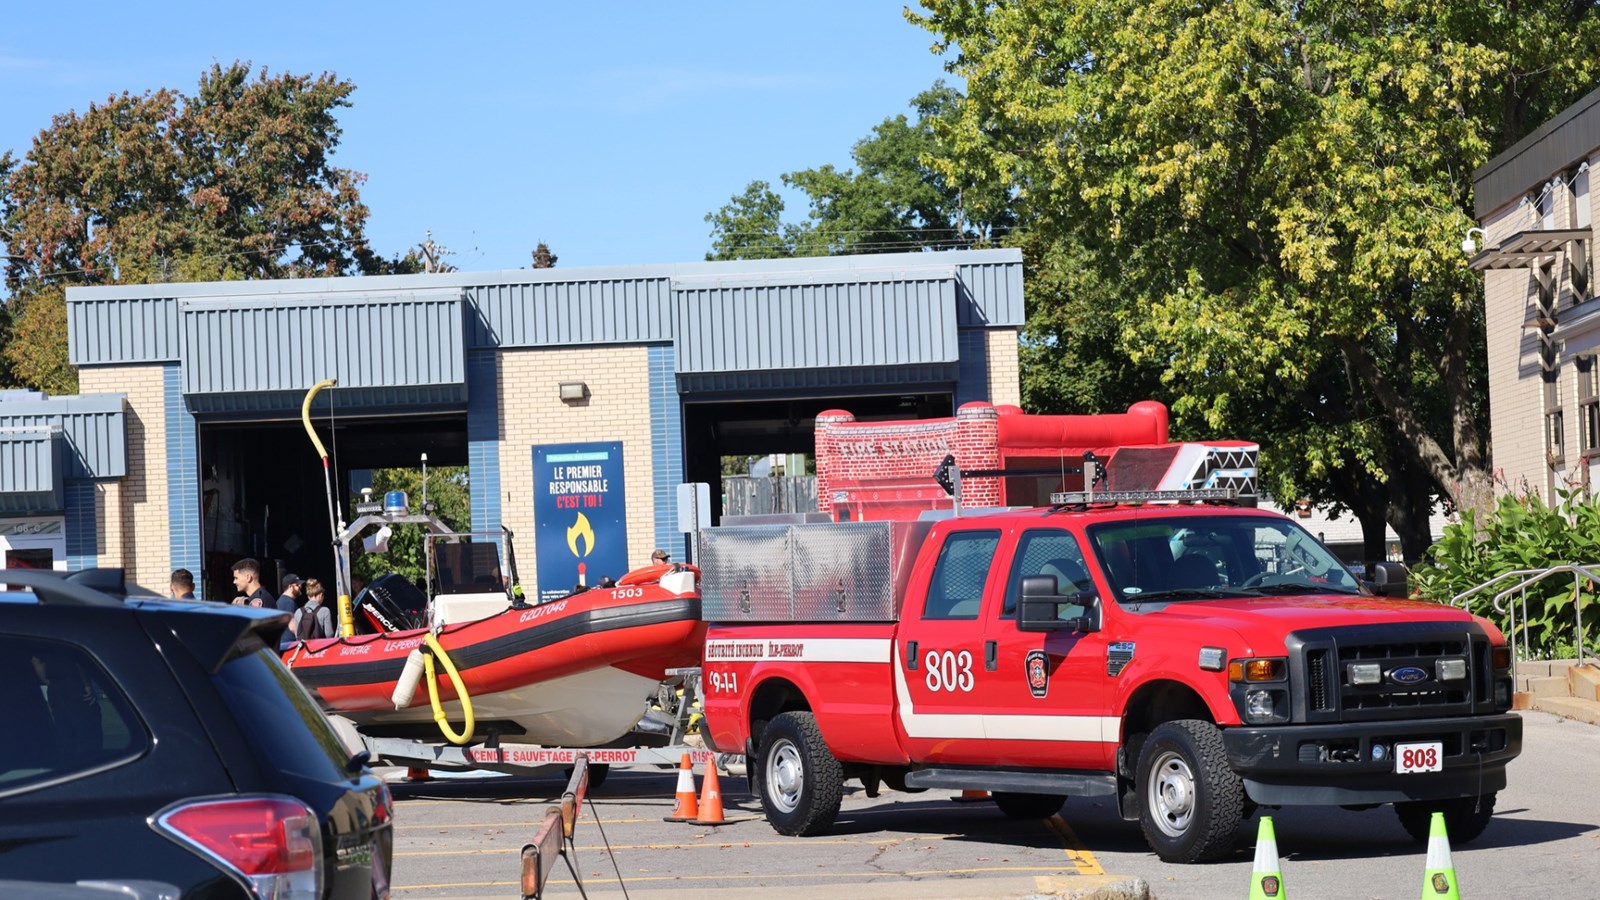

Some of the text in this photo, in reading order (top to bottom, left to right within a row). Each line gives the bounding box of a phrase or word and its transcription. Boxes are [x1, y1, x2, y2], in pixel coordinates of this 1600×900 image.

[839, 437, 949, 457] FIRE STATION
[554, 465, 603, 480] LE PREMIER
[549, 479, 608, 495] RESPONSABLE
[556, 495, 581, 509] C'EST
[582, 494, 597, 508] TOI
[610, 587, 643, 600] 1503
[520, 600, 569, 623] 62D7048
[708, 641, 735, 658] SÉCURITÉ
[735, 643, 764, 658] INCENDIE
[925, 649, 975, 693] 803
[513, 751, 572, 763] SAUVETAGE
[1402, 748, 1437, 769] 803
